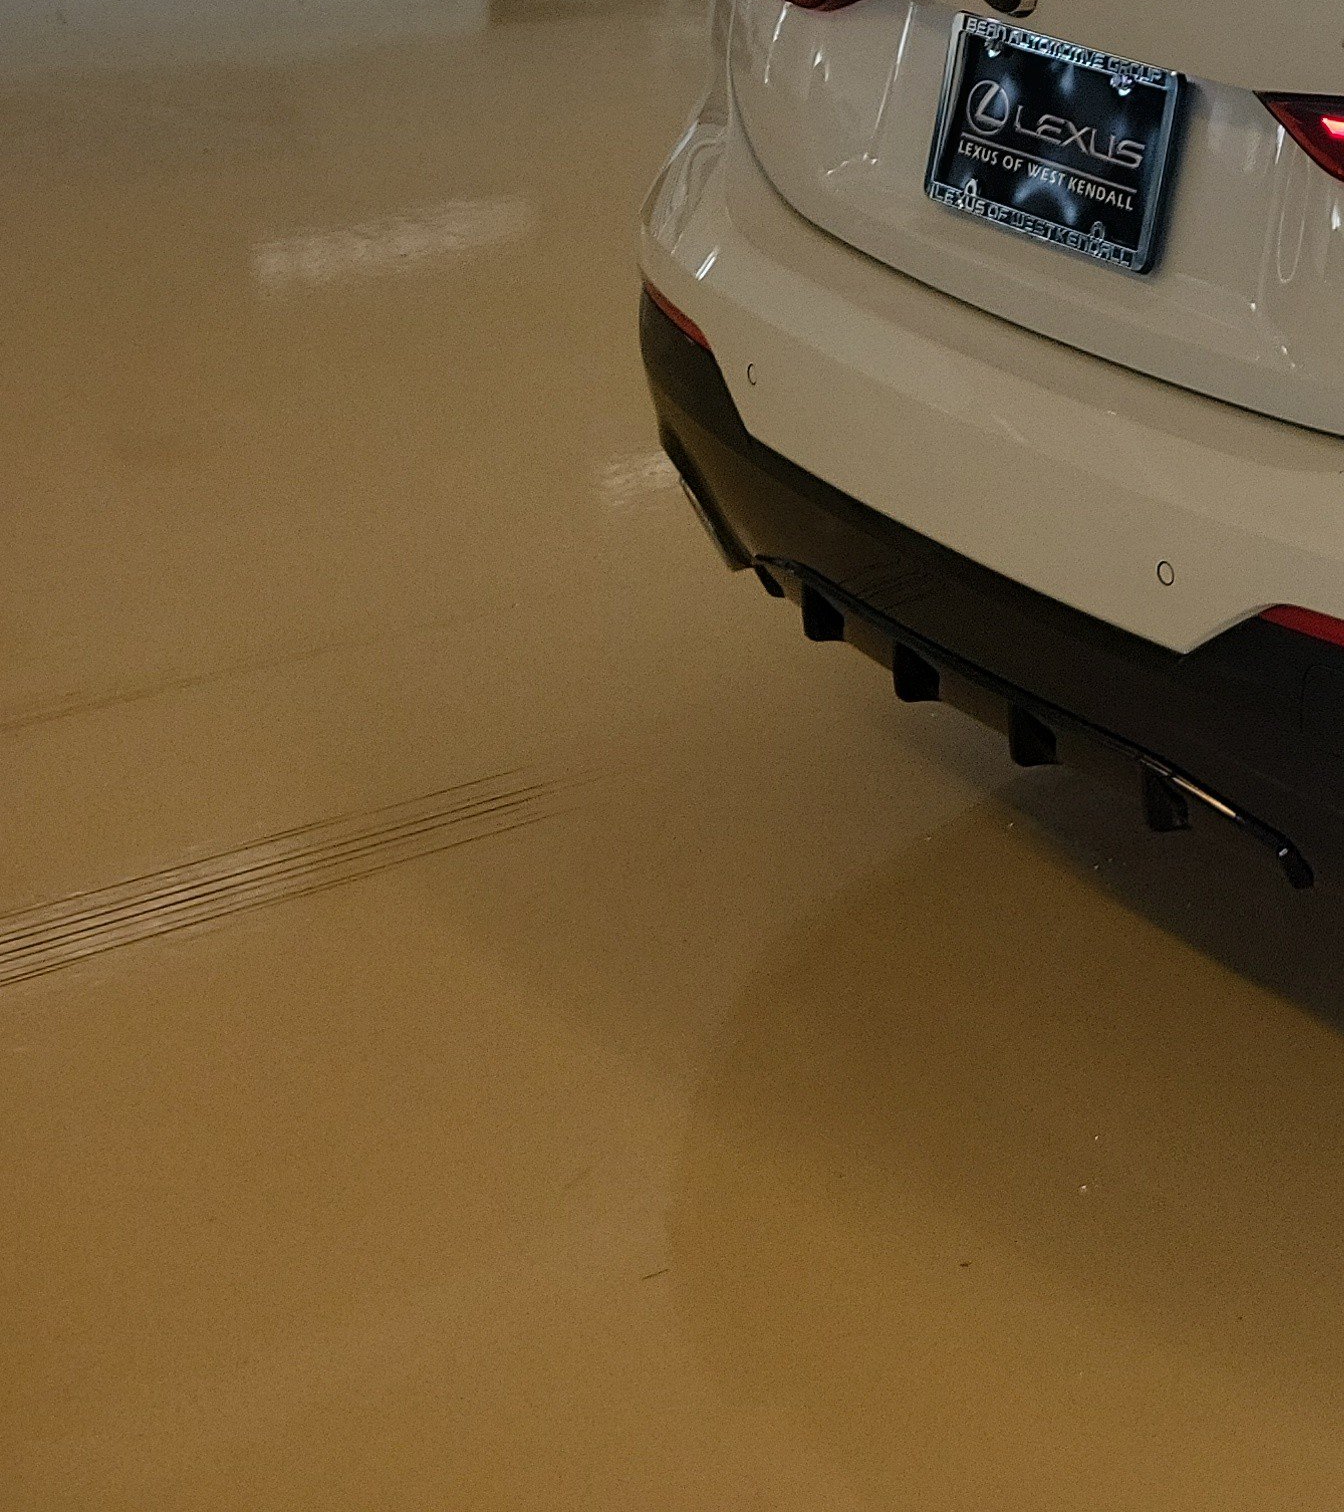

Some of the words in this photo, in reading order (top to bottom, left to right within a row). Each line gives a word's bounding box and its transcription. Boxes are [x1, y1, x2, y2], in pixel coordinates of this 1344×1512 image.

[1008, 29, 1105, 68] AUTOMOTIVE
[1107, 57, 1162, 83] GROUP
[1015, 105, 1147, 170] LEXUS
[958, 139, 998, 166] LEXUS
[1002, 155, 1023, 173] OF
[1028, 162, 1067, 187] WEST
[1068, 176, 1134, 211] KENDALL
[934, 183, 985, 215] LEXUS
[987, 204, 1009, 221] OF
[1010, 211, 1057, 238] WEST
[1055, 227, 1130, 266] KENDALL
